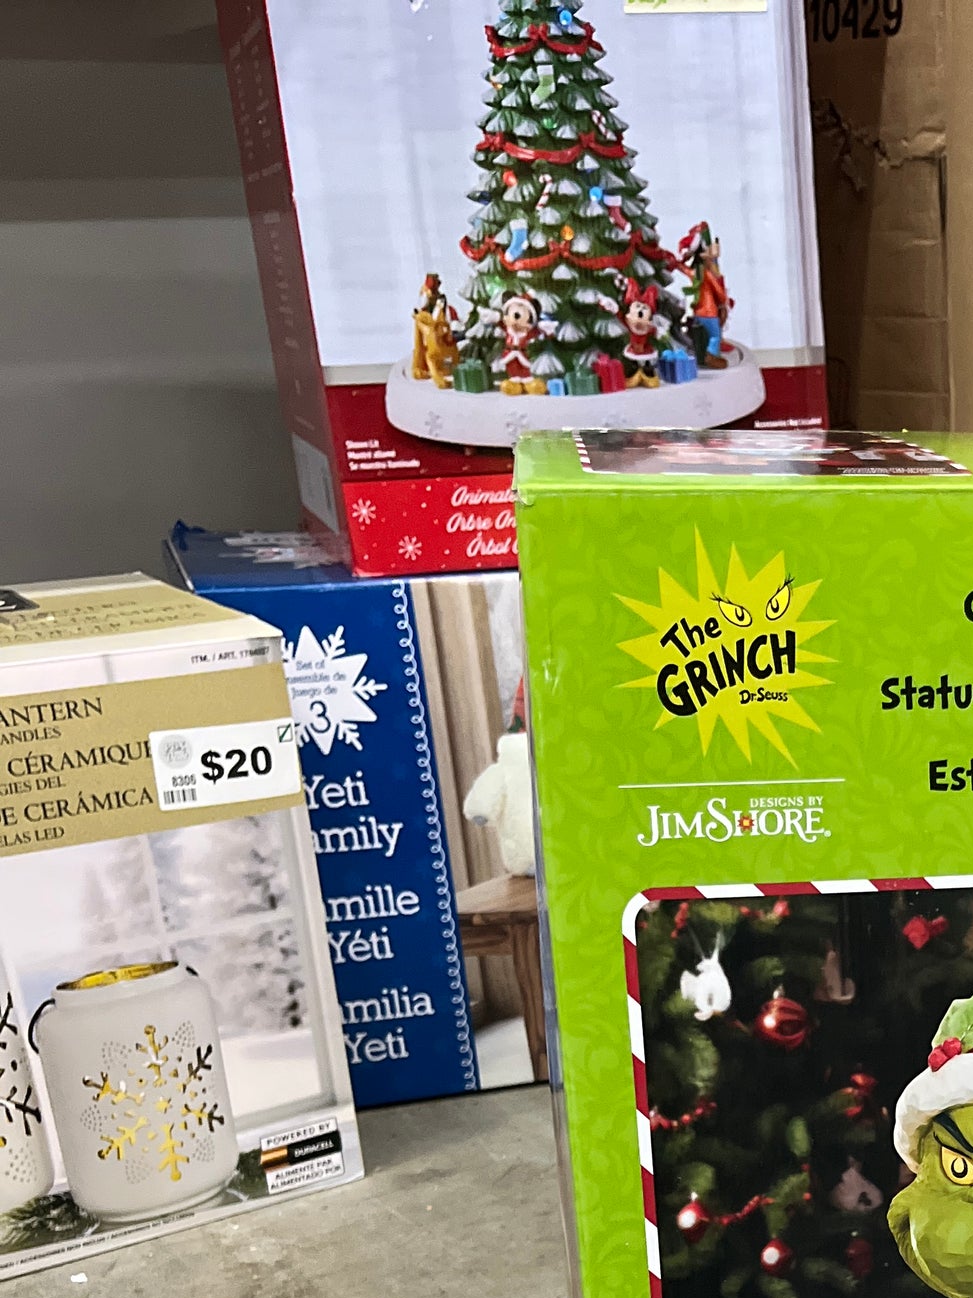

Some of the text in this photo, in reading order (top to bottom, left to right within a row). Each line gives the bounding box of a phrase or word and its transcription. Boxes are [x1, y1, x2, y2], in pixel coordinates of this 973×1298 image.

[466, 531, 511, 557] Árbol
[660, 617, 722, 659] The
[657, 629, 796, 717] GRINCH
[310, 700, 332, 733] 3
[36, 776, 67, 792] DEL
[201, 746, 273, 785] $20
[0, 787, 154, 827] E CERÁMICA
[302, 770, 370, 810] Yeti
[750, 796, 824, 808] DESIGNS BY
[35, 826, 65, 842] LED
[326, 884, 421, 922] mille
[328, 926, 394, 964] Yéti
[344, 1026, 410, 1065] Yeti
